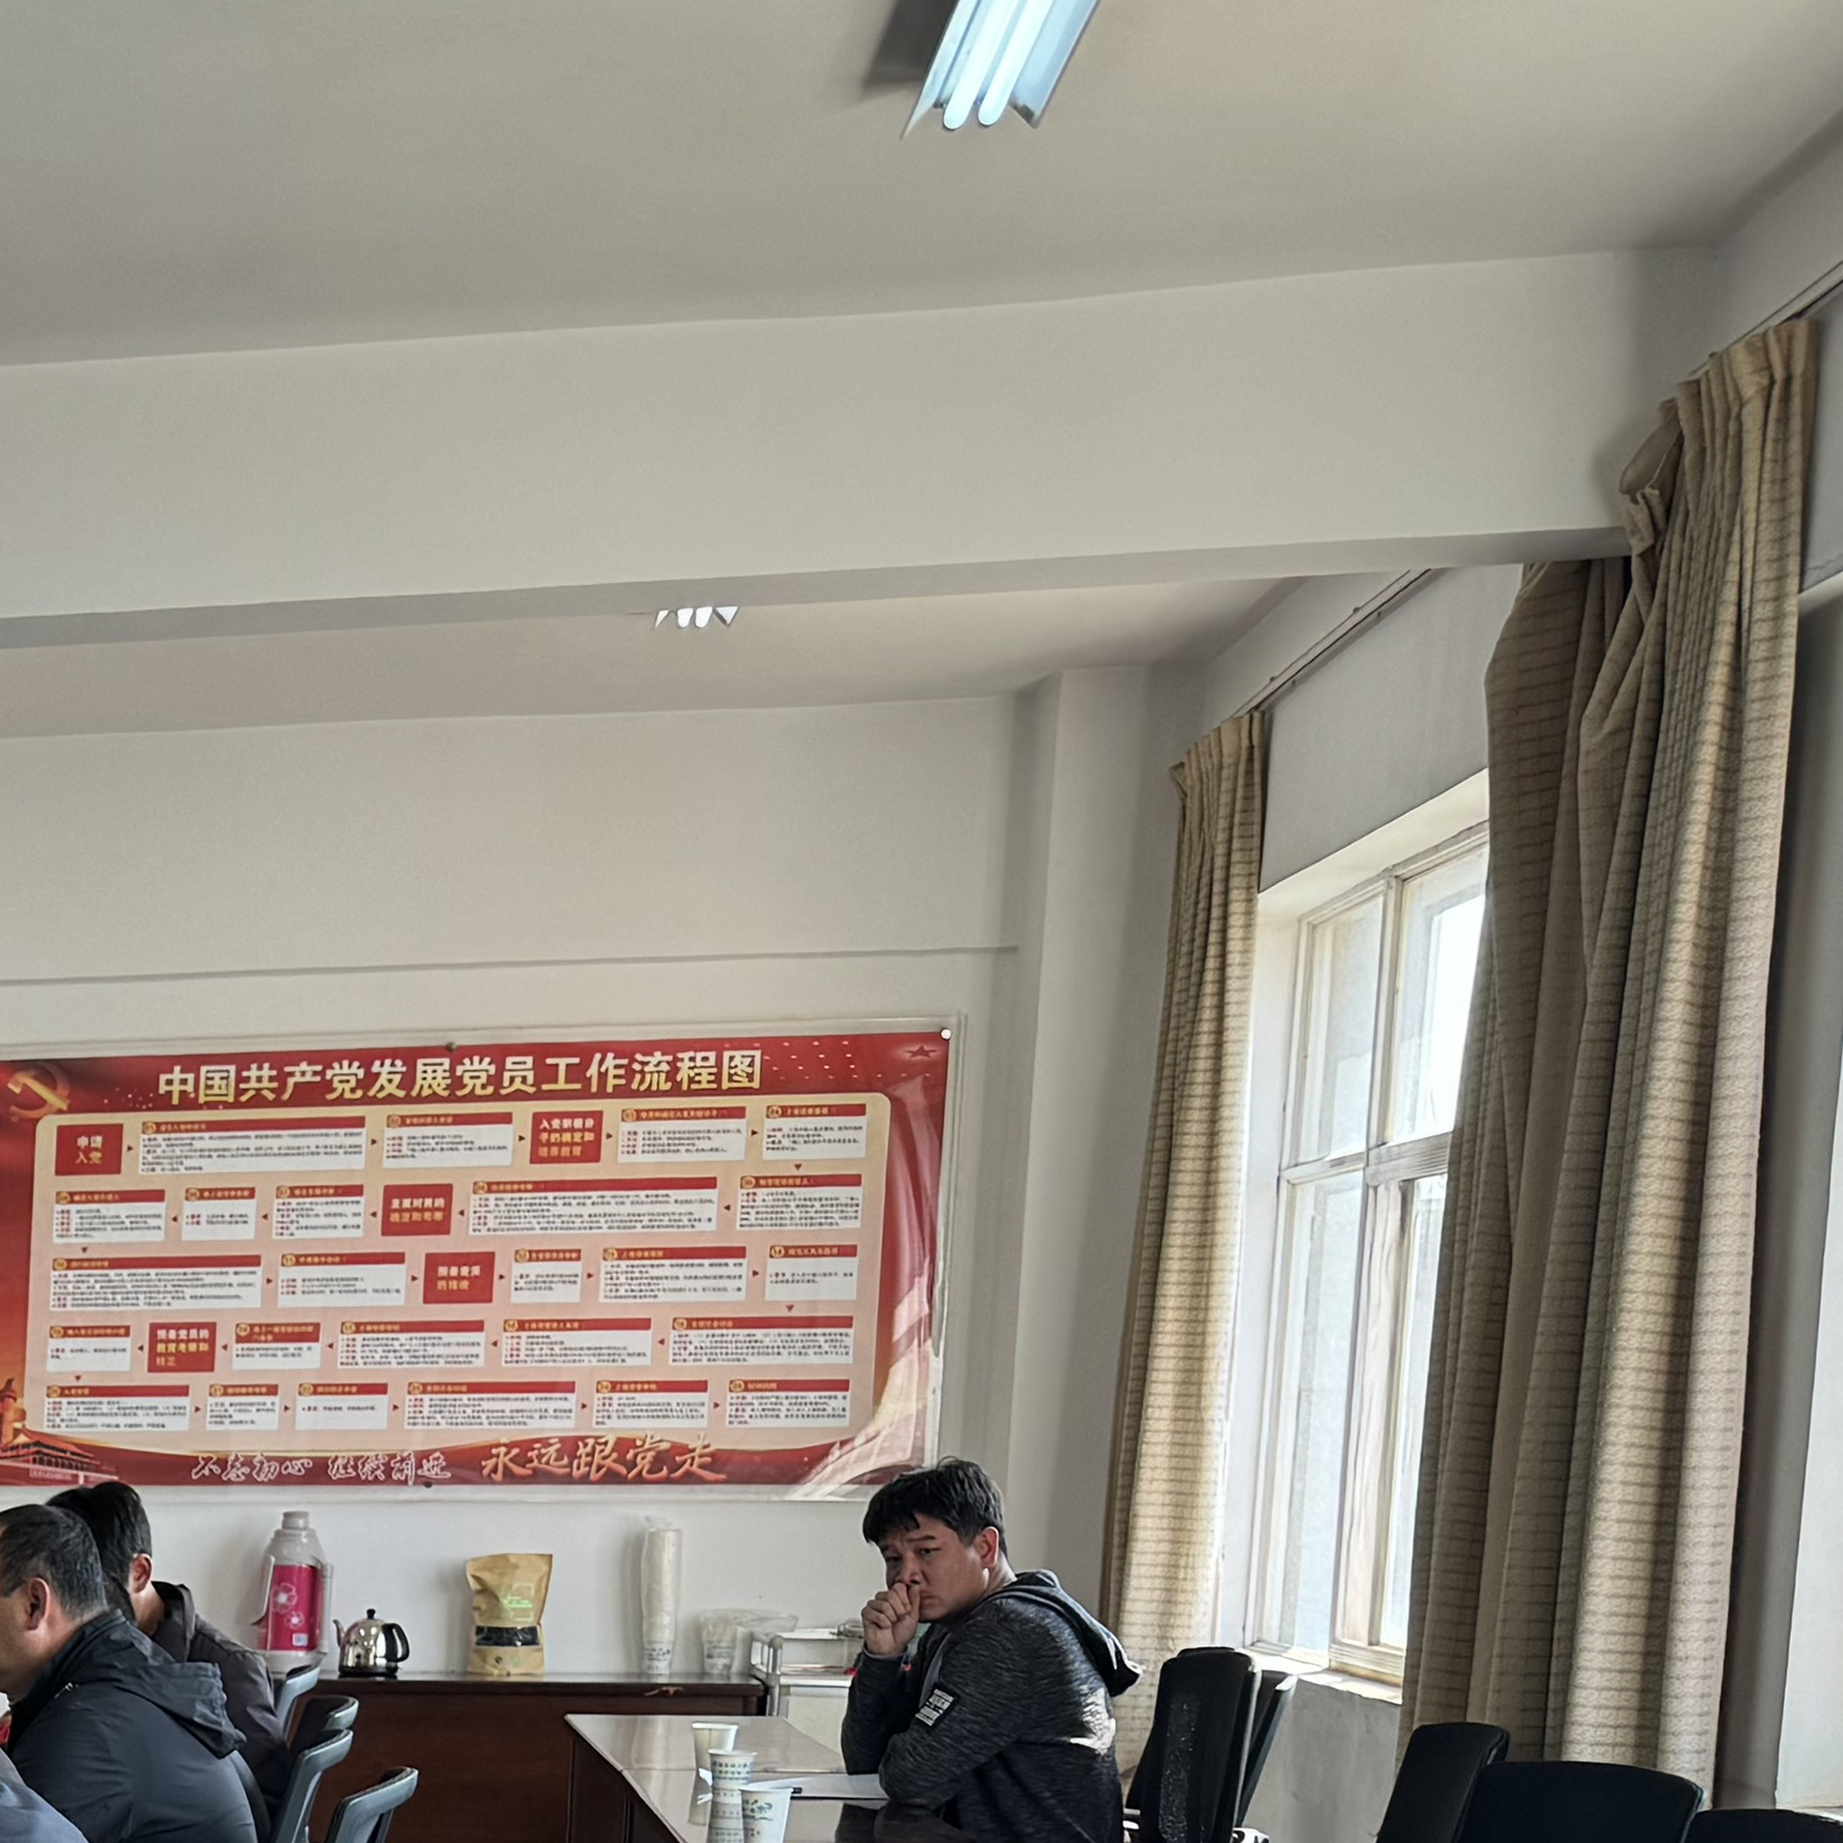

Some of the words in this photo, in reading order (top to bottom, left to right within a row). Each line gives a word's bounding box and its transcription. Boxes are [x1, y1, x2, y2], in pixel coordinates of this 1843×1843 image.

[158, 1049, 763, 1105] 中国共产党发展党员工作流程图
[75, 1151, 103, 1165] 入党
[192, 1449, 313, 1483] 不忘初心
[327, 1450, 452, 1486] 继续前进
[481, 1430, 728, 1483] 永远跟党走
